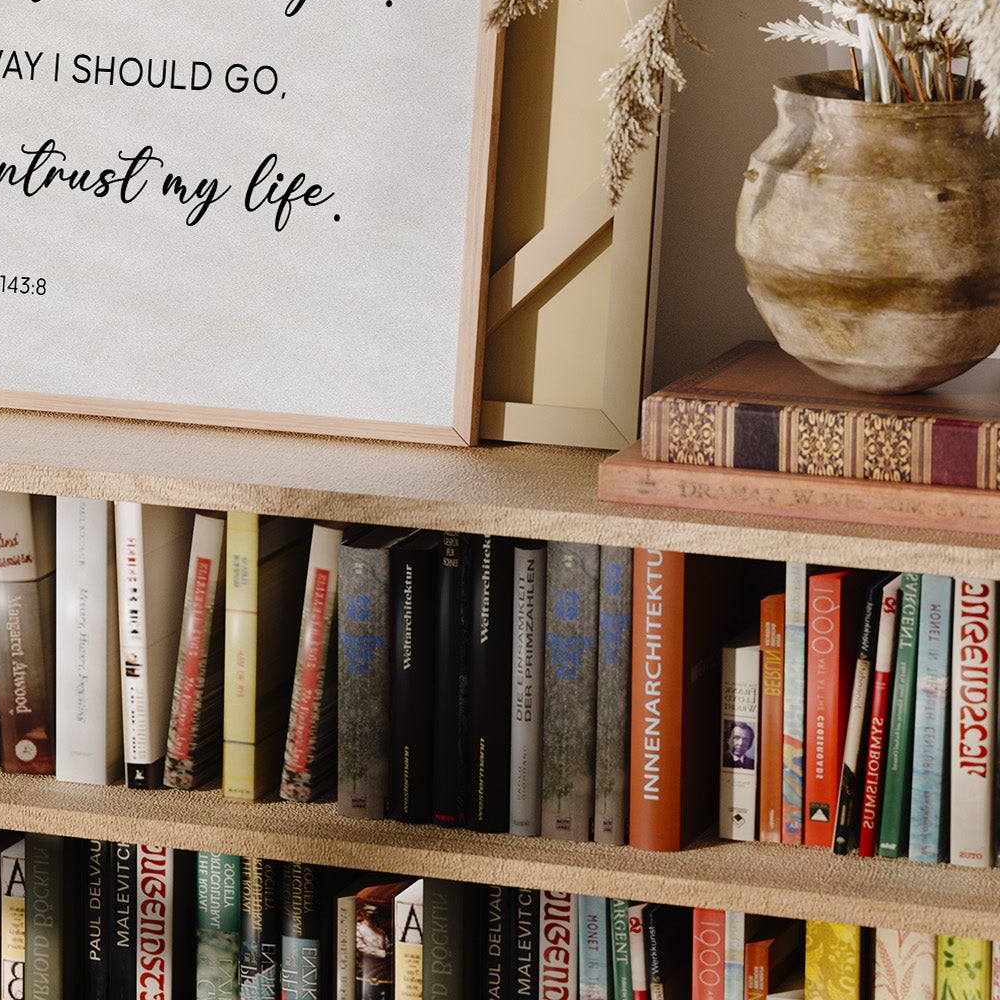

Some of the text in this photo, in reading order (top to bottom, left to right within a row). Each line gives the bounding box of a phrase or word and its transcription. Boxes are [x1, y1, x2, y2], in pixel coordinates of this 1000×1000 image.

[55, 53, 59, 81] I
[72, 54, 211, 90] SHOULD
[226, 64, 285, 99] GO,
[163, 174, 231, 226] my
[245, 154, 340, 232] life.
[1, 276, 46, 295] 143:8
[402, 563, 413, 671] Weltarchitektur
[524, 559, 536, 722] DER PRIMZAHLEN
[5, 595, 32, 715] Margaret Atwood
[516, 690, 524, 722] DIE
[402, 745, 410, 814] westermann
[478, 737, 486, 821] westermann
[89, 921, 102, 961] PAUL
[587, 914, 599, 953] MONET
[649, 925, 657, 974] Werkkunst
[698, 921, 720, 989] 1900
